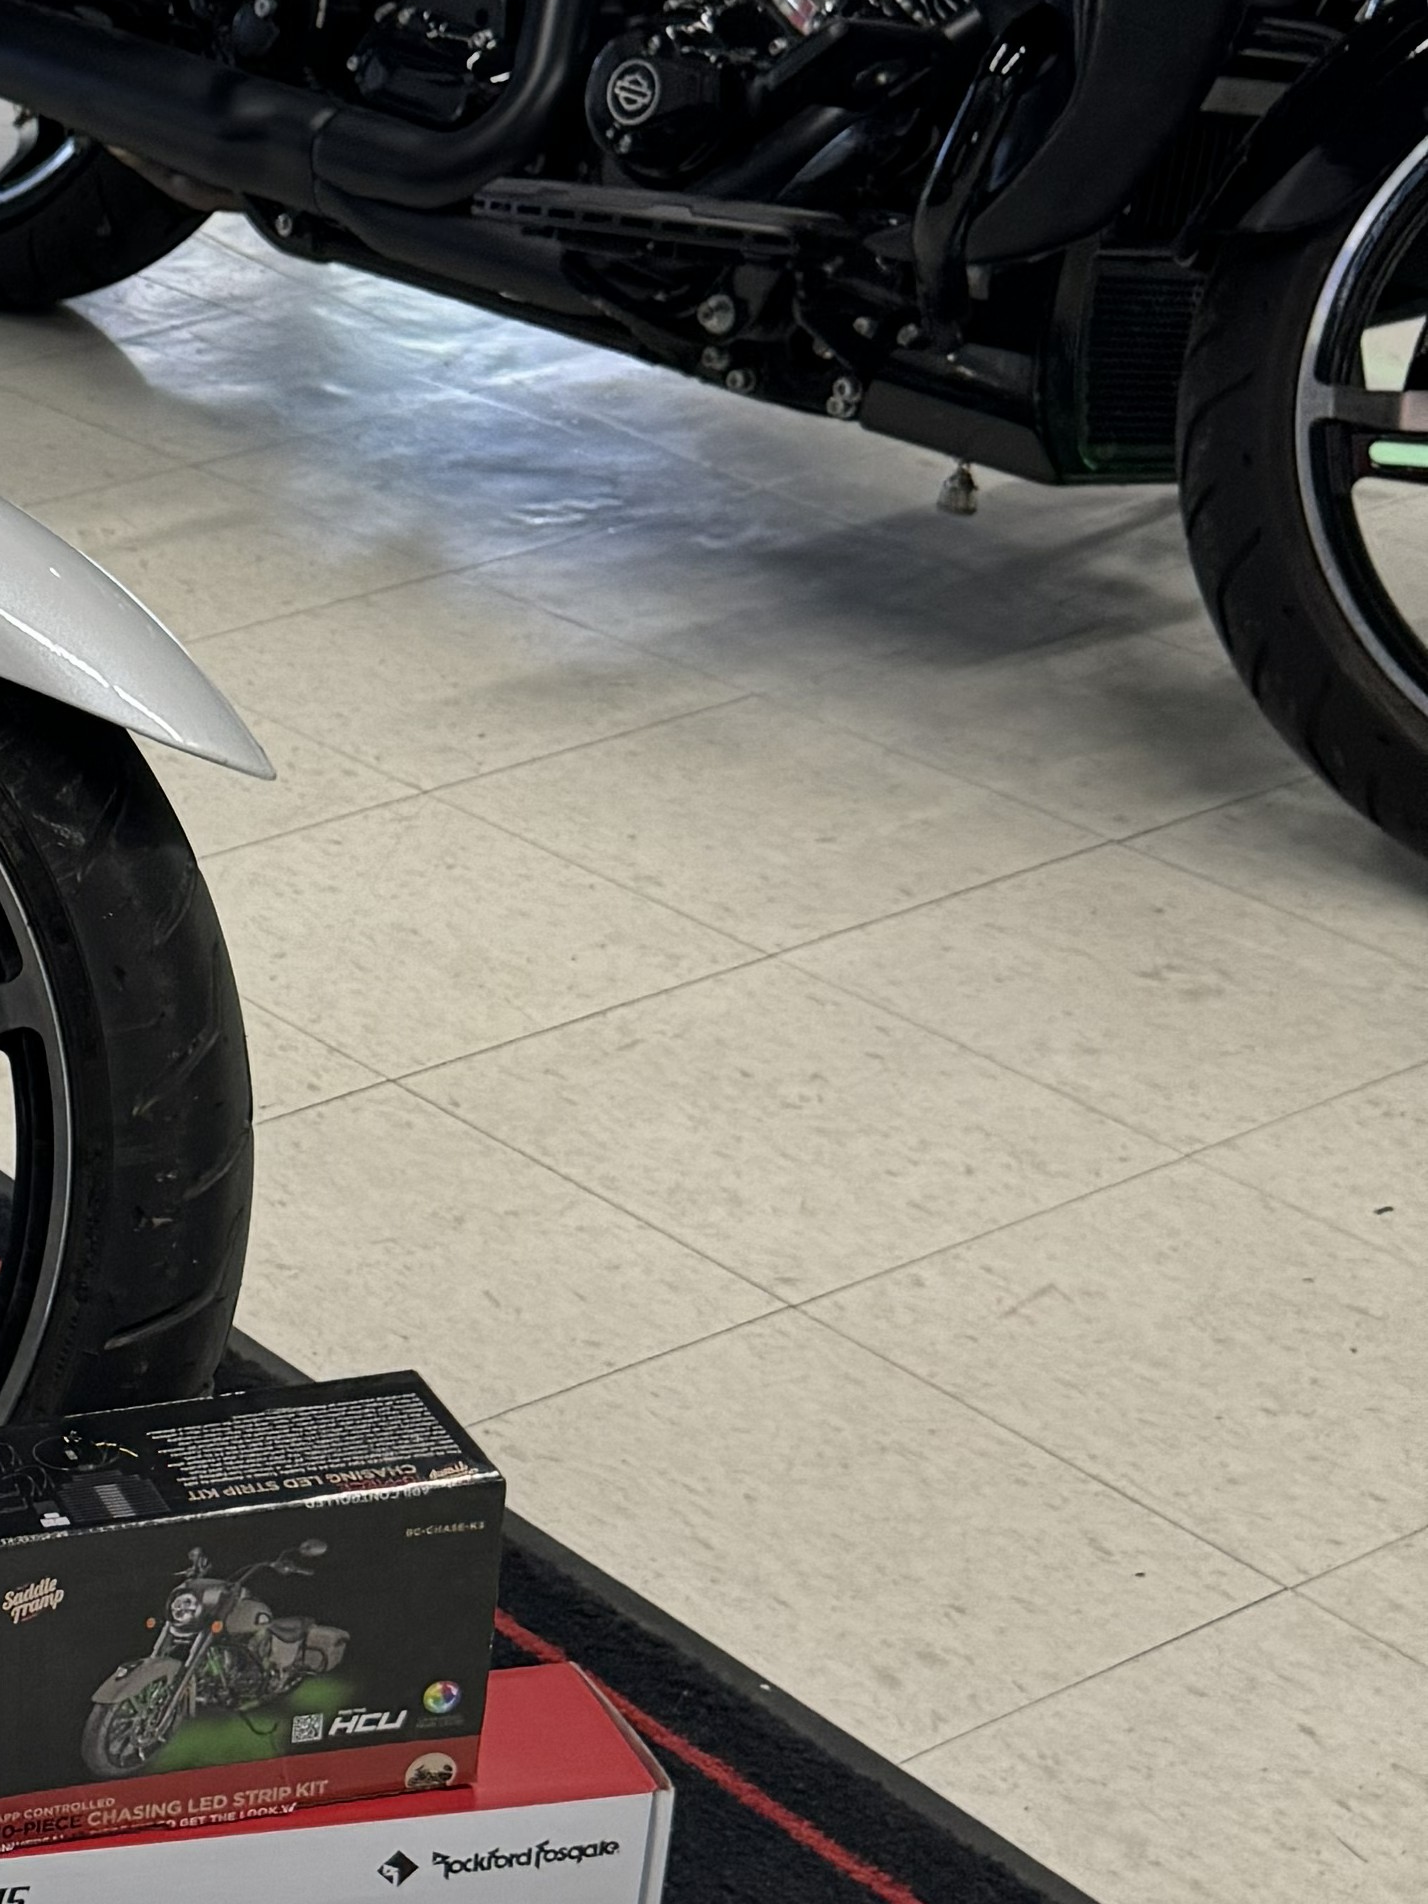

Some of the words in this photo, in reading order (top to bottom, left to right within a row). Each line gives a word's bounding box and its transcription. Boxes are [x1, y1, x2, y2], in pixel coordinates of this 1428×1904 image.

[283, 1474, 324, 1490] LED
[326, 1463, 417, 1485] CHASING
[187, 1485, 220, 1502] KIT
[223, 1479, 281, 1497] STRIP
[2, 1577, 58, 1611] Saddle
[10, 1589, 65, 1625] Tramp
[328, 1709, 408, 1737] HCU
[23, 1797, 116, 1820] CONTROLLED
[87, 1798, 182, 1827] CHASING
[188, 1794, 228, 1814] LED
[233, 1786, 292, 1807] STRIP
[295, 1779, 329, 1798] KIT
[433, 1848, 532, 1880] Rockford
[534, 1839, 620, 1869] Fosgate
